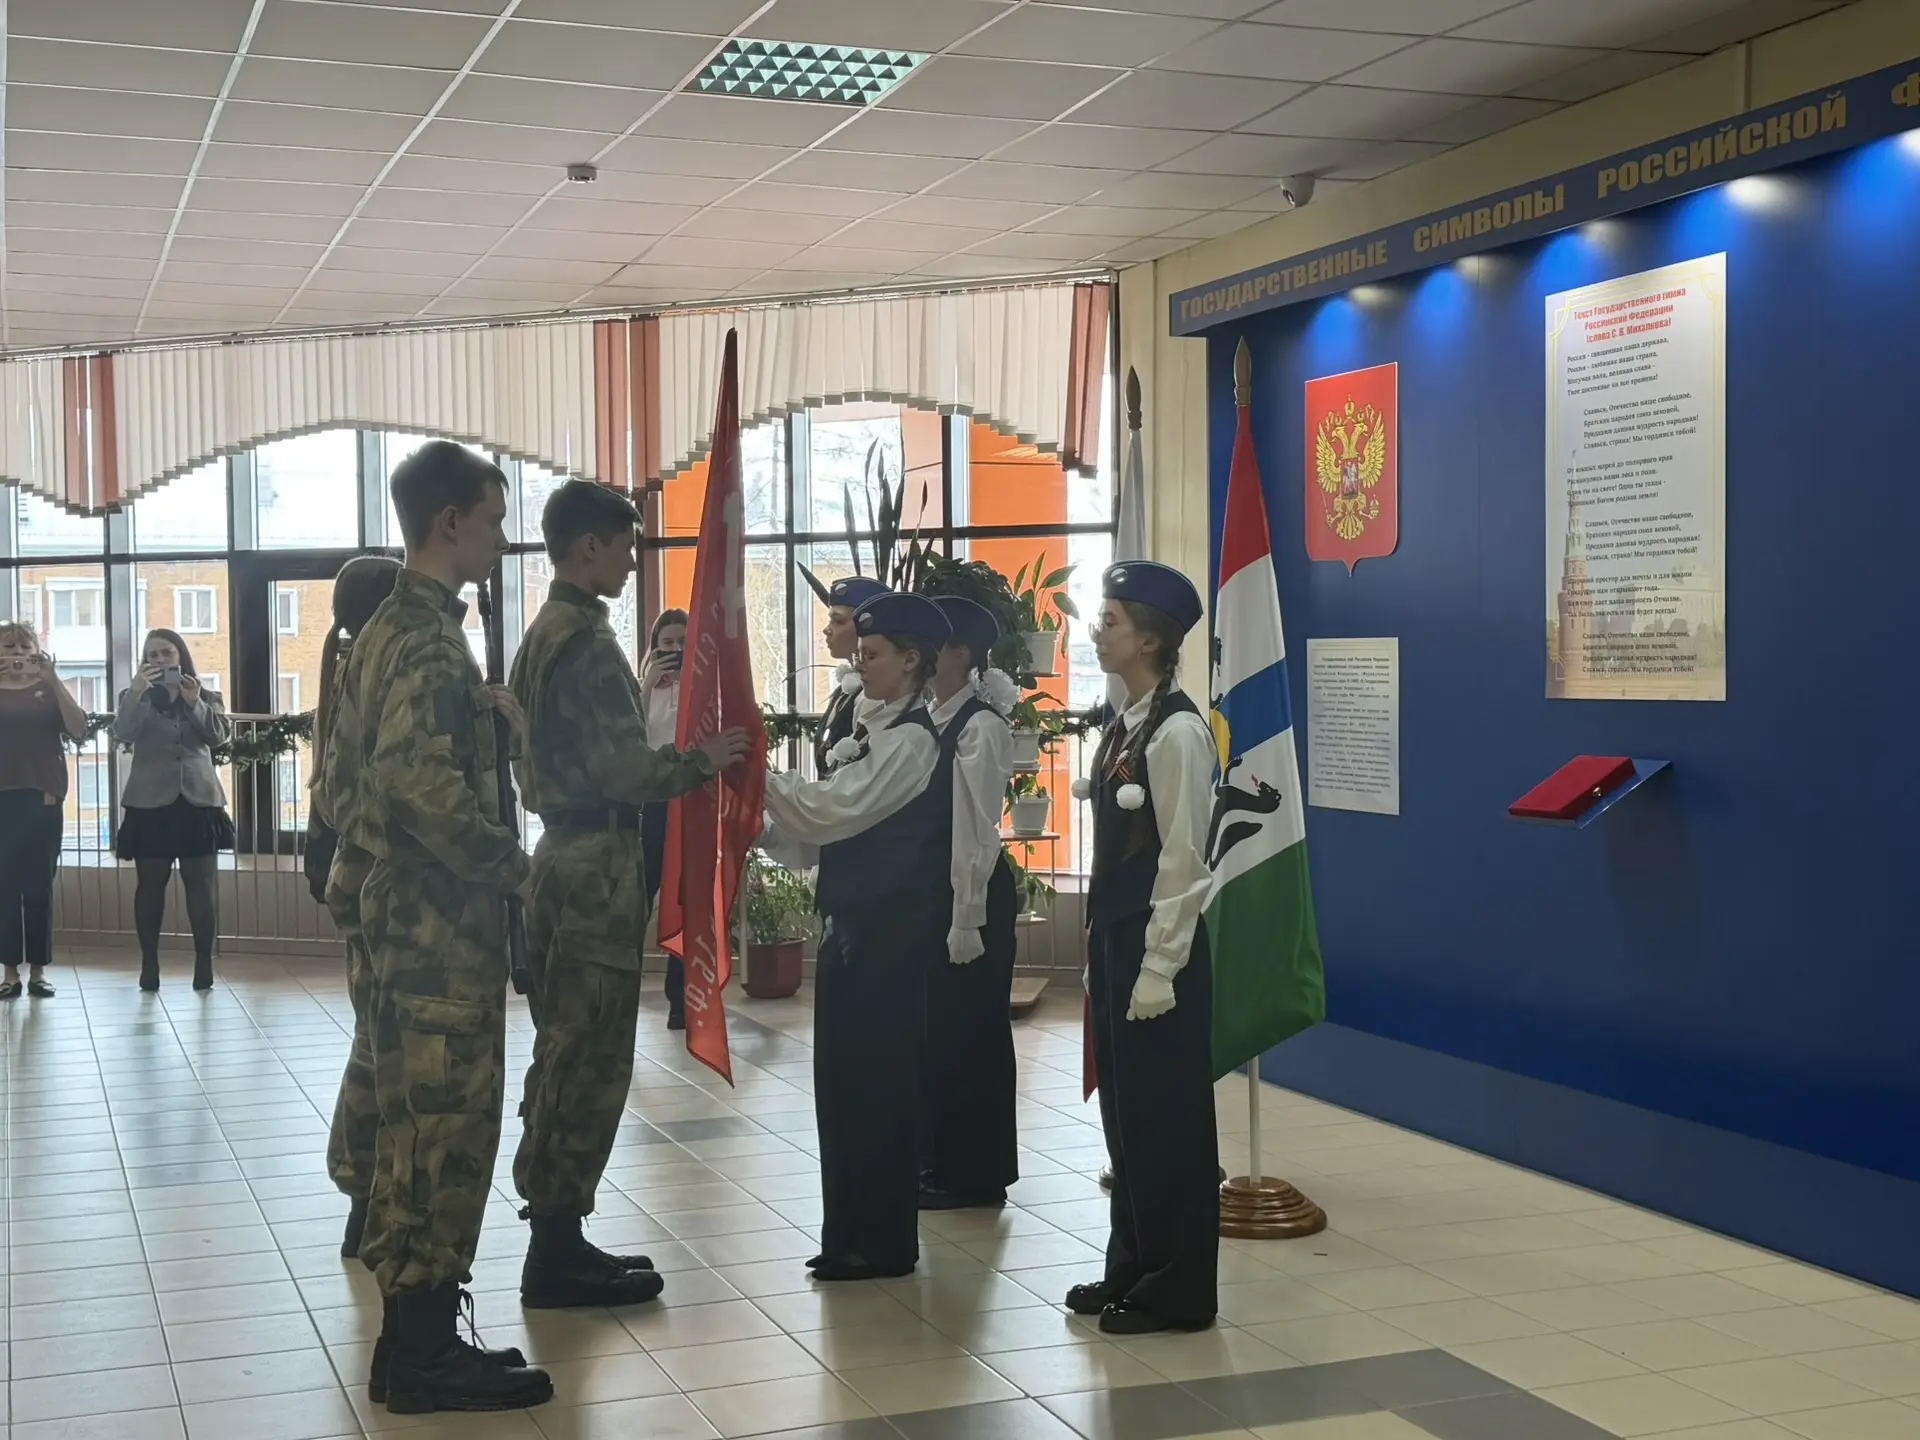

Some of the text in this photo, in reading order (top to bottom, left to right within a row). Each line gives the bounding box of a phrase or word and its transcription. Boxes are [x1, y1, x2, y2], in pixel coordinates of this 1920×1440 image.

[1181, 240, 1388, 323] ГОСУДАРСТВЕННЫЕ
[1413, 183, 1564, 252] СИМВОЛЫ
[1597, 90, 1847, 199] РОССИЙСКОЙ
